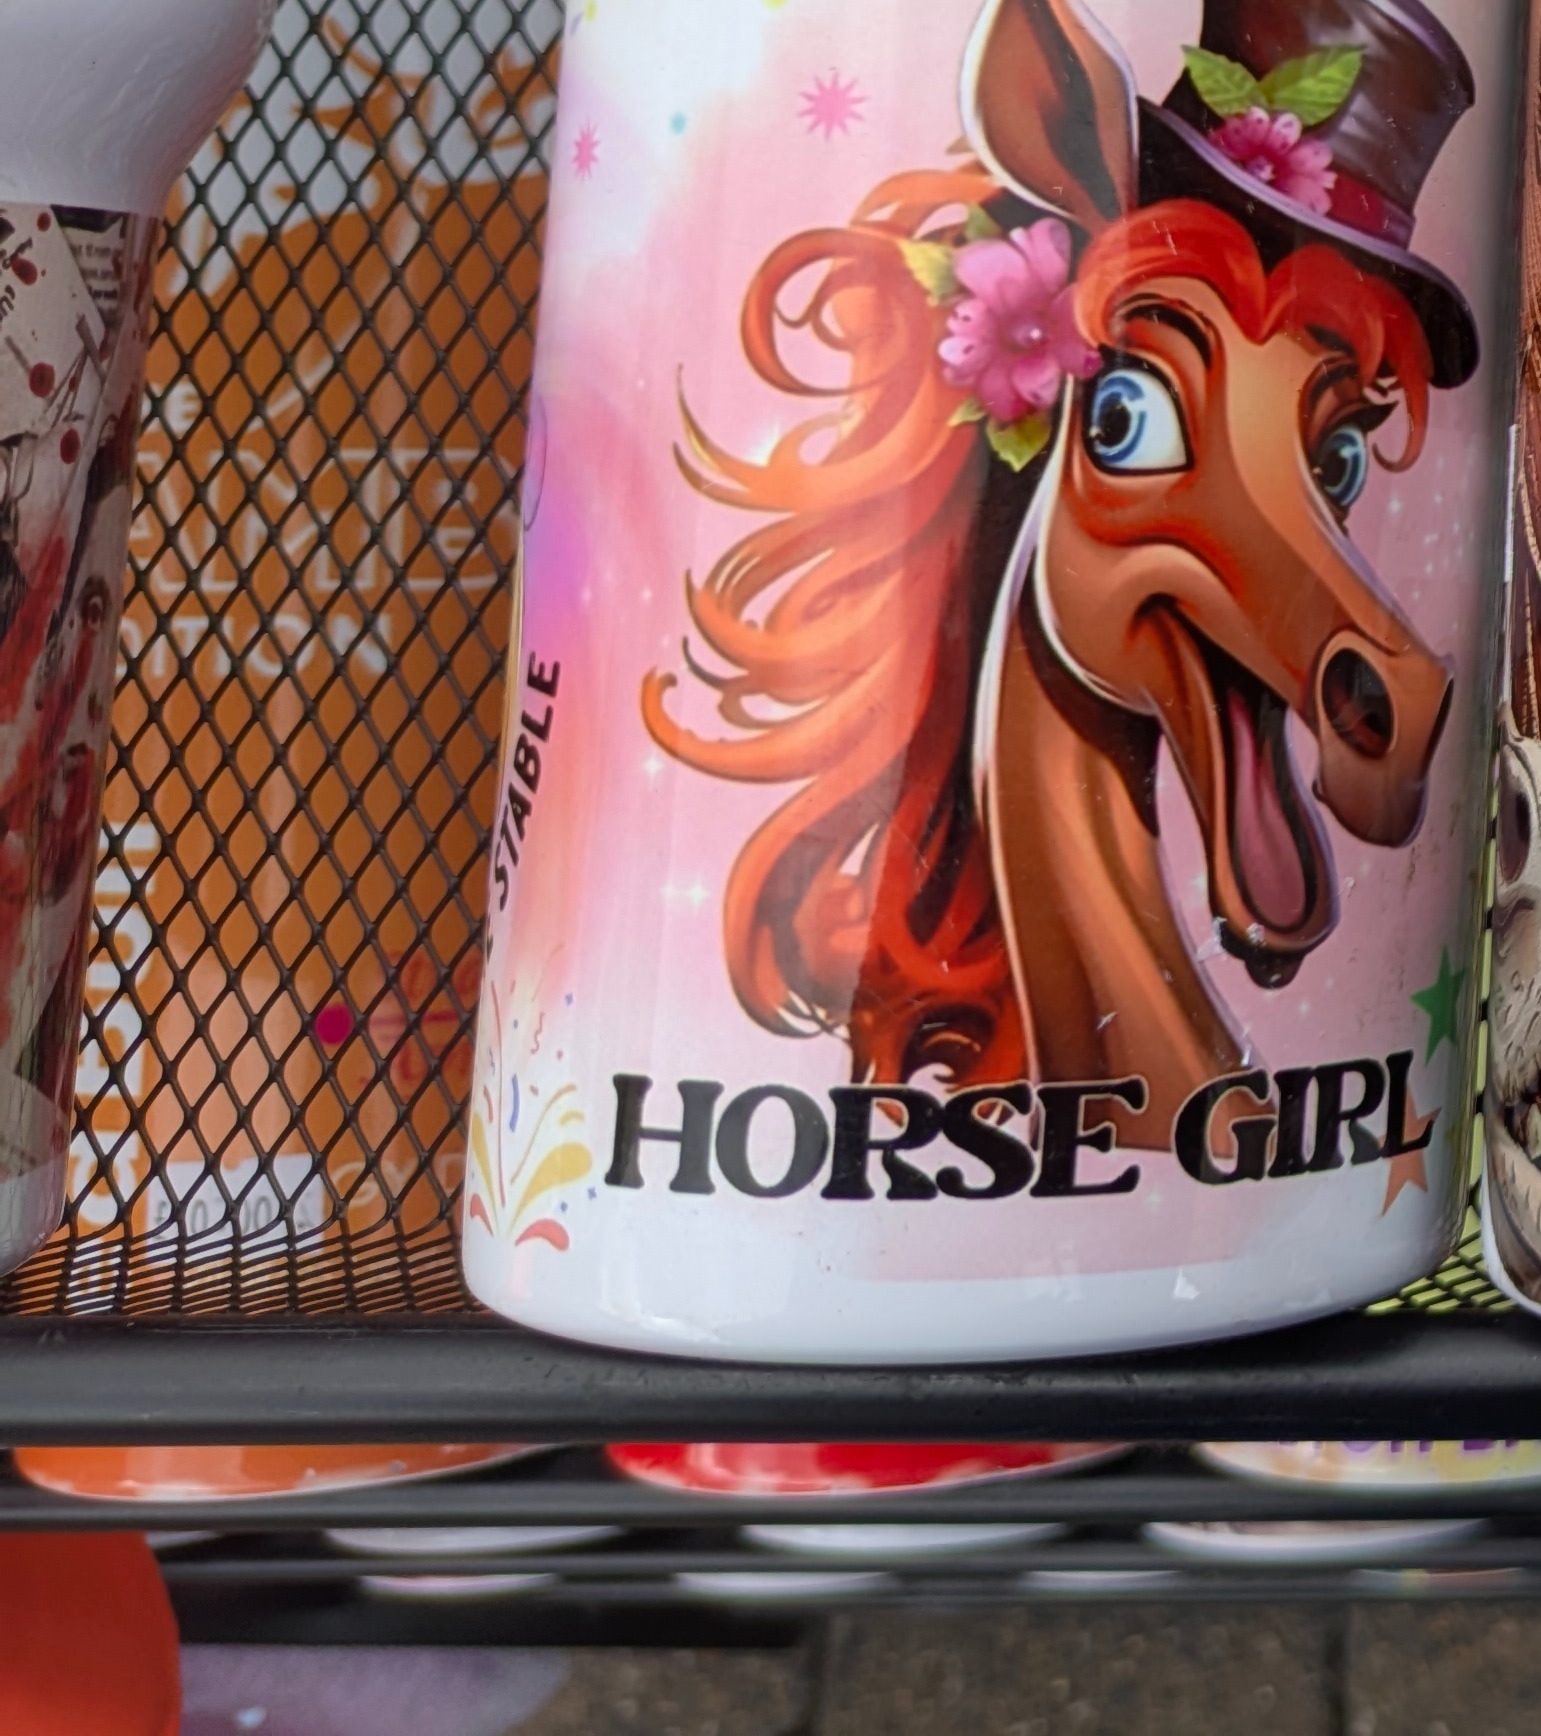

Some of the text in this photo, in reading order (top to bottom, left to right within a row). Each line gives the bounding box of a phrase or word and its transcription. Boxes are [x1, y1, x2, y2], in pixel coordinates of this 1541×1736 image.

[492, 650, 562, 913] STABLE
[604, 1049, 1436, 1202] HORSE GIRL
